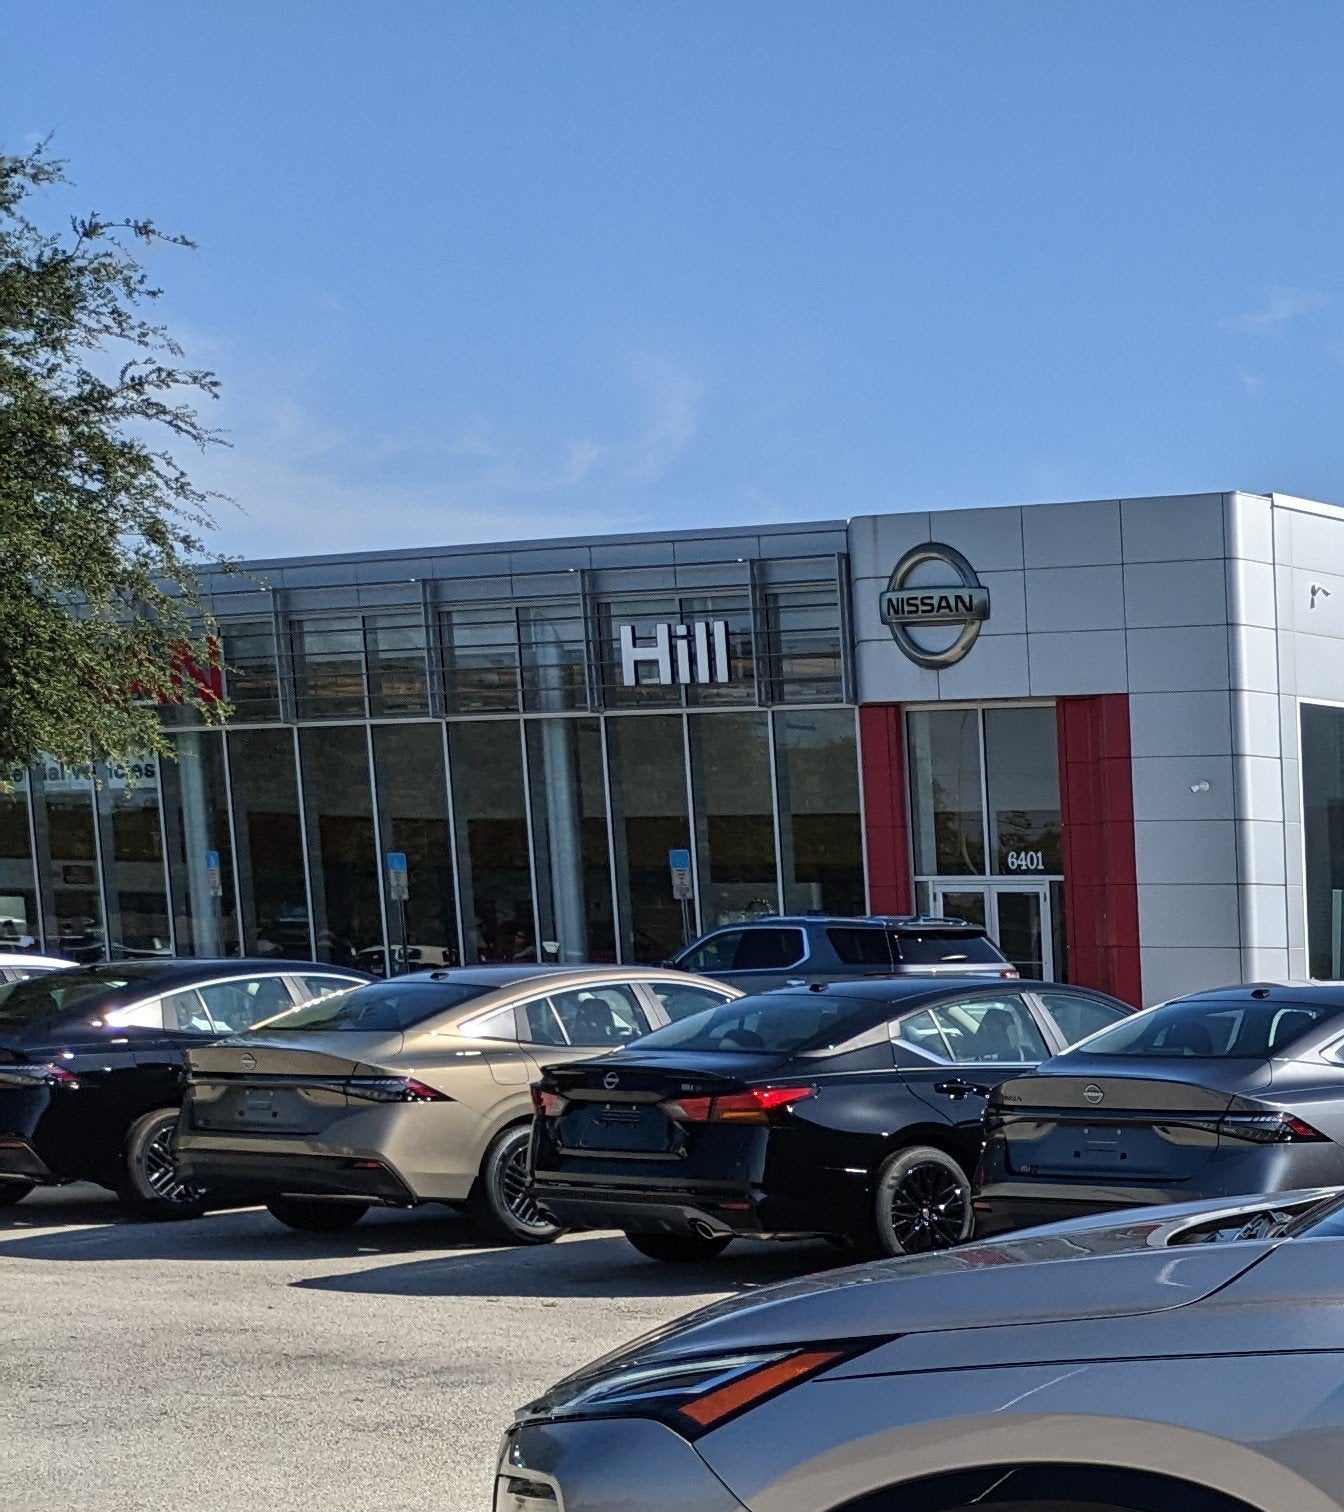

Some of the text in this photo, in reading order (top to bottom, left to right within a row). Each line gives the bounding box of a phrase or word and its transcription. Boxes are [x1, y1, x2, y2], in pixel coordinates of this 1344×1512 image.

[886, 594, 974, 617] NISSAN
[620, 620, 729, 687] Hill
[1008, 850, 1044, 870] 6401
